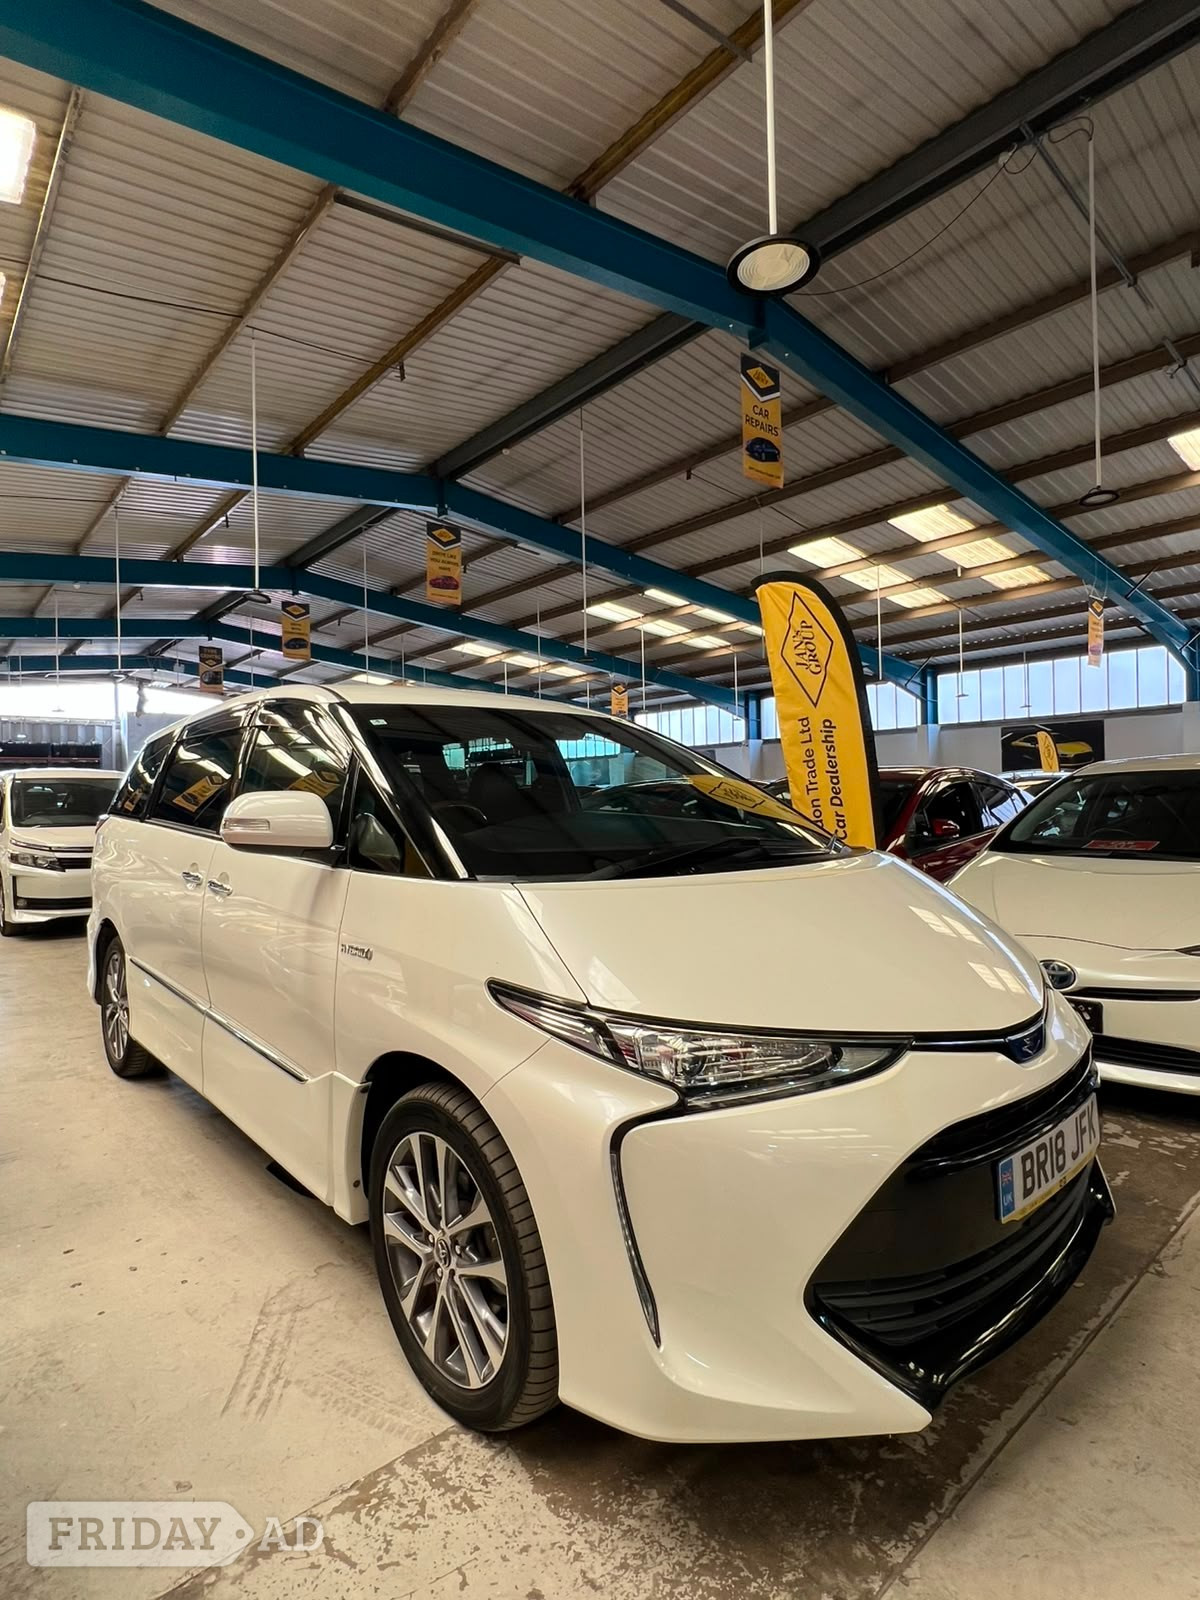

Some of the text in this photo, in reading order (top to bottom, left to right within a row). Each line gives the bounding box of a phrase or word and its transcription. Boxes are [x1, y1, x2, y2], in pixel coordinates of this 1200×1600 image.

[745, 414, 779, 437] REPAIRS
[752, 404, 769, 420] CAR
[800, 620, 822, 675] GROUP
[798, 716, 813, 745] Ltd
[803, 748, 819, 796] Trade
[820, 718, 848, 841] Car Dealership
[1021, 1129, 1067, 1200] BR18
[1071, 1100, 1097, 1161] JFK
[1003, 1192, 1015, 1206] UK
